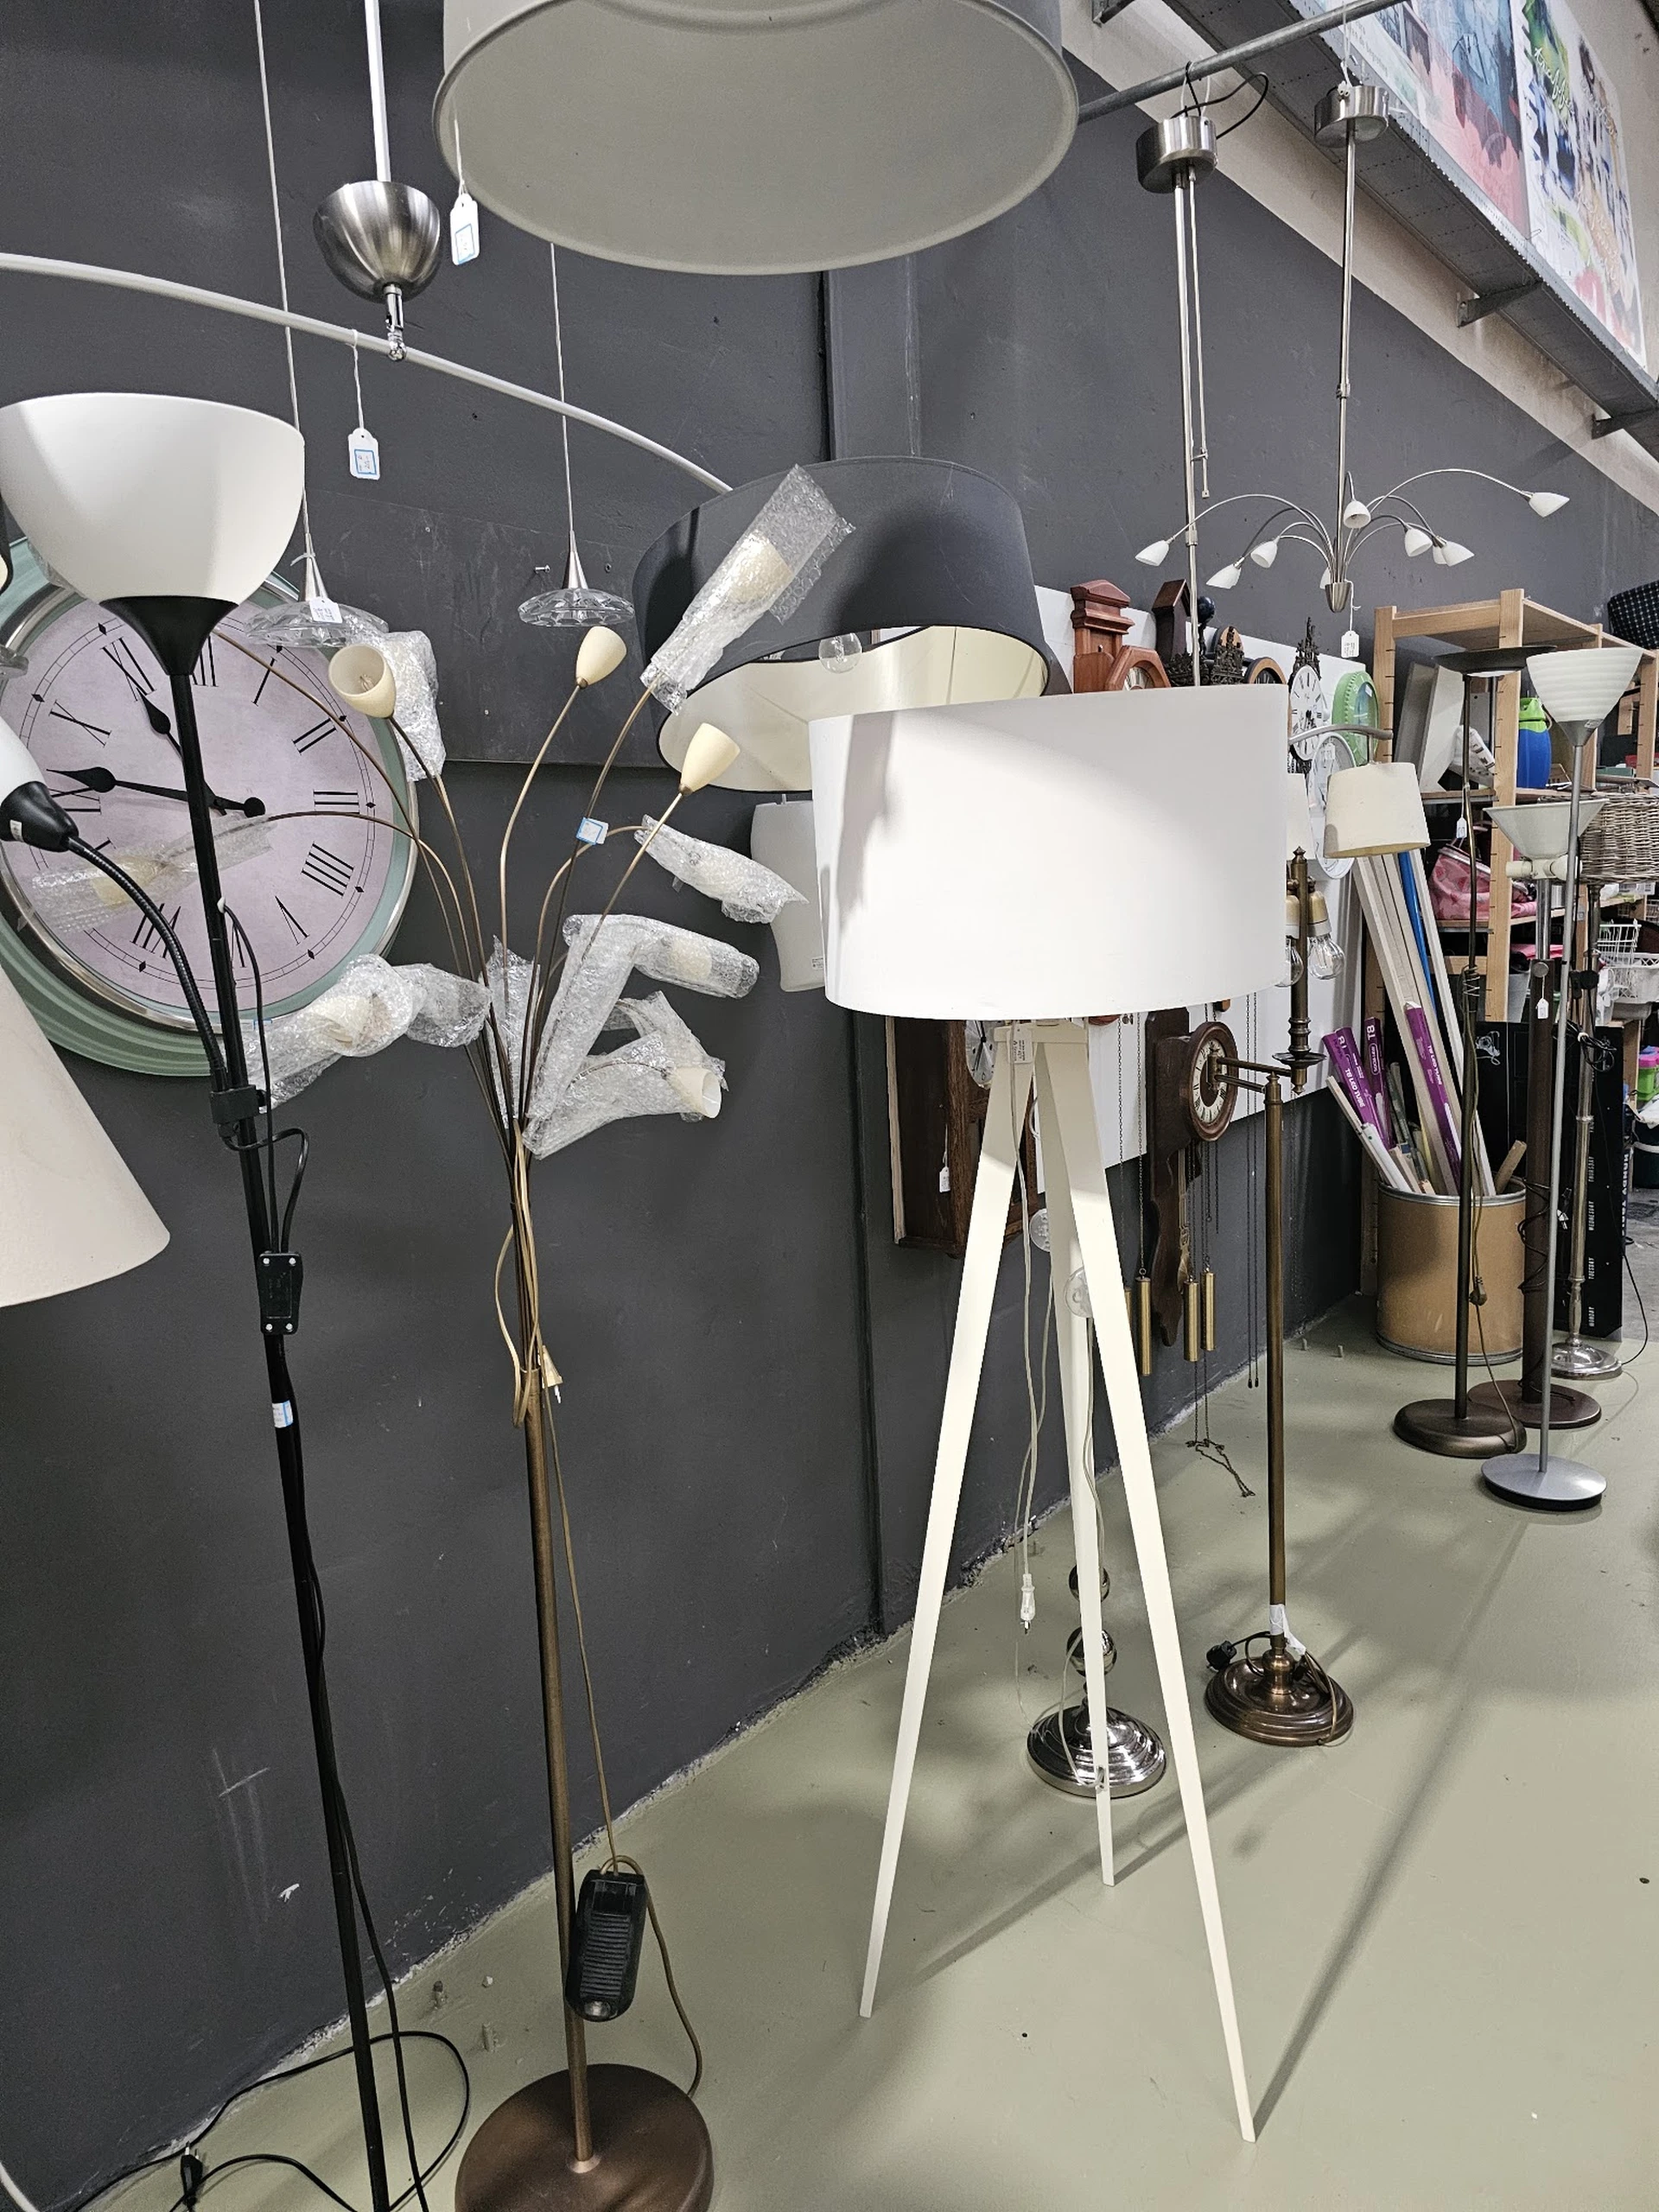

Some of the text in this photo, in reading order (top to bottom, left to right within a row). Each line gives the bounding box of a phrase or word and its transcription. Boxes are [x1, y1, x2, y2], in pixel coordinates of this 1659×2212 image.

[99, 637, 156, 702] XI
[48, 700, 111, 747] X
[291, 717, 337, 755] II
[302, 841, 354, 899] IIII
[275, 895, 310, 946] V
